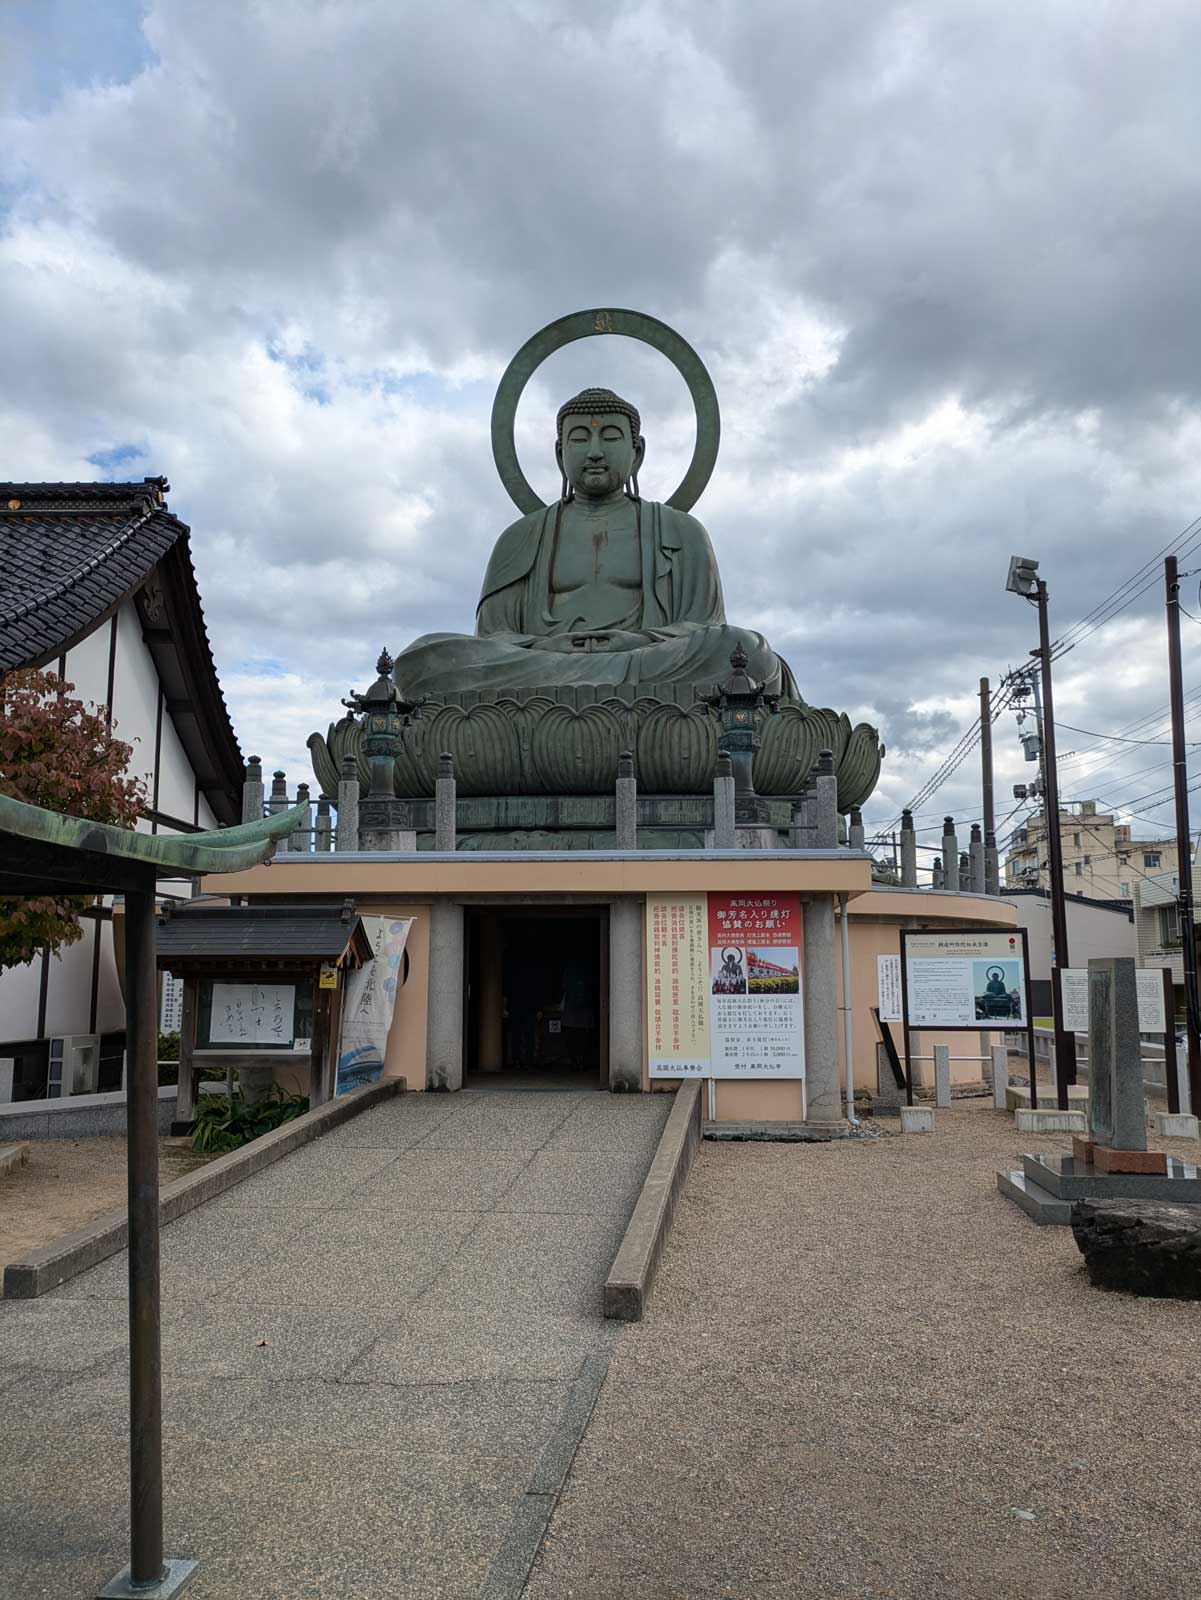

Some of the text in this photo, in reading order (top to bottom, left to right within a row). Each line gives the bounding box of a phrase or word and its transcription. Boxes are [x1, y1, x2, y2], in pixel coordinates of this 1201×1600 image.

[730, 899, 776, 907] 高岡大仏祭り
[717, 910, 790, 919] 御芳名入り提灯
[722, 920, 786, 929] 協賛のお願い
[360, 927, 383, 1014] ようこそ北陸へ
